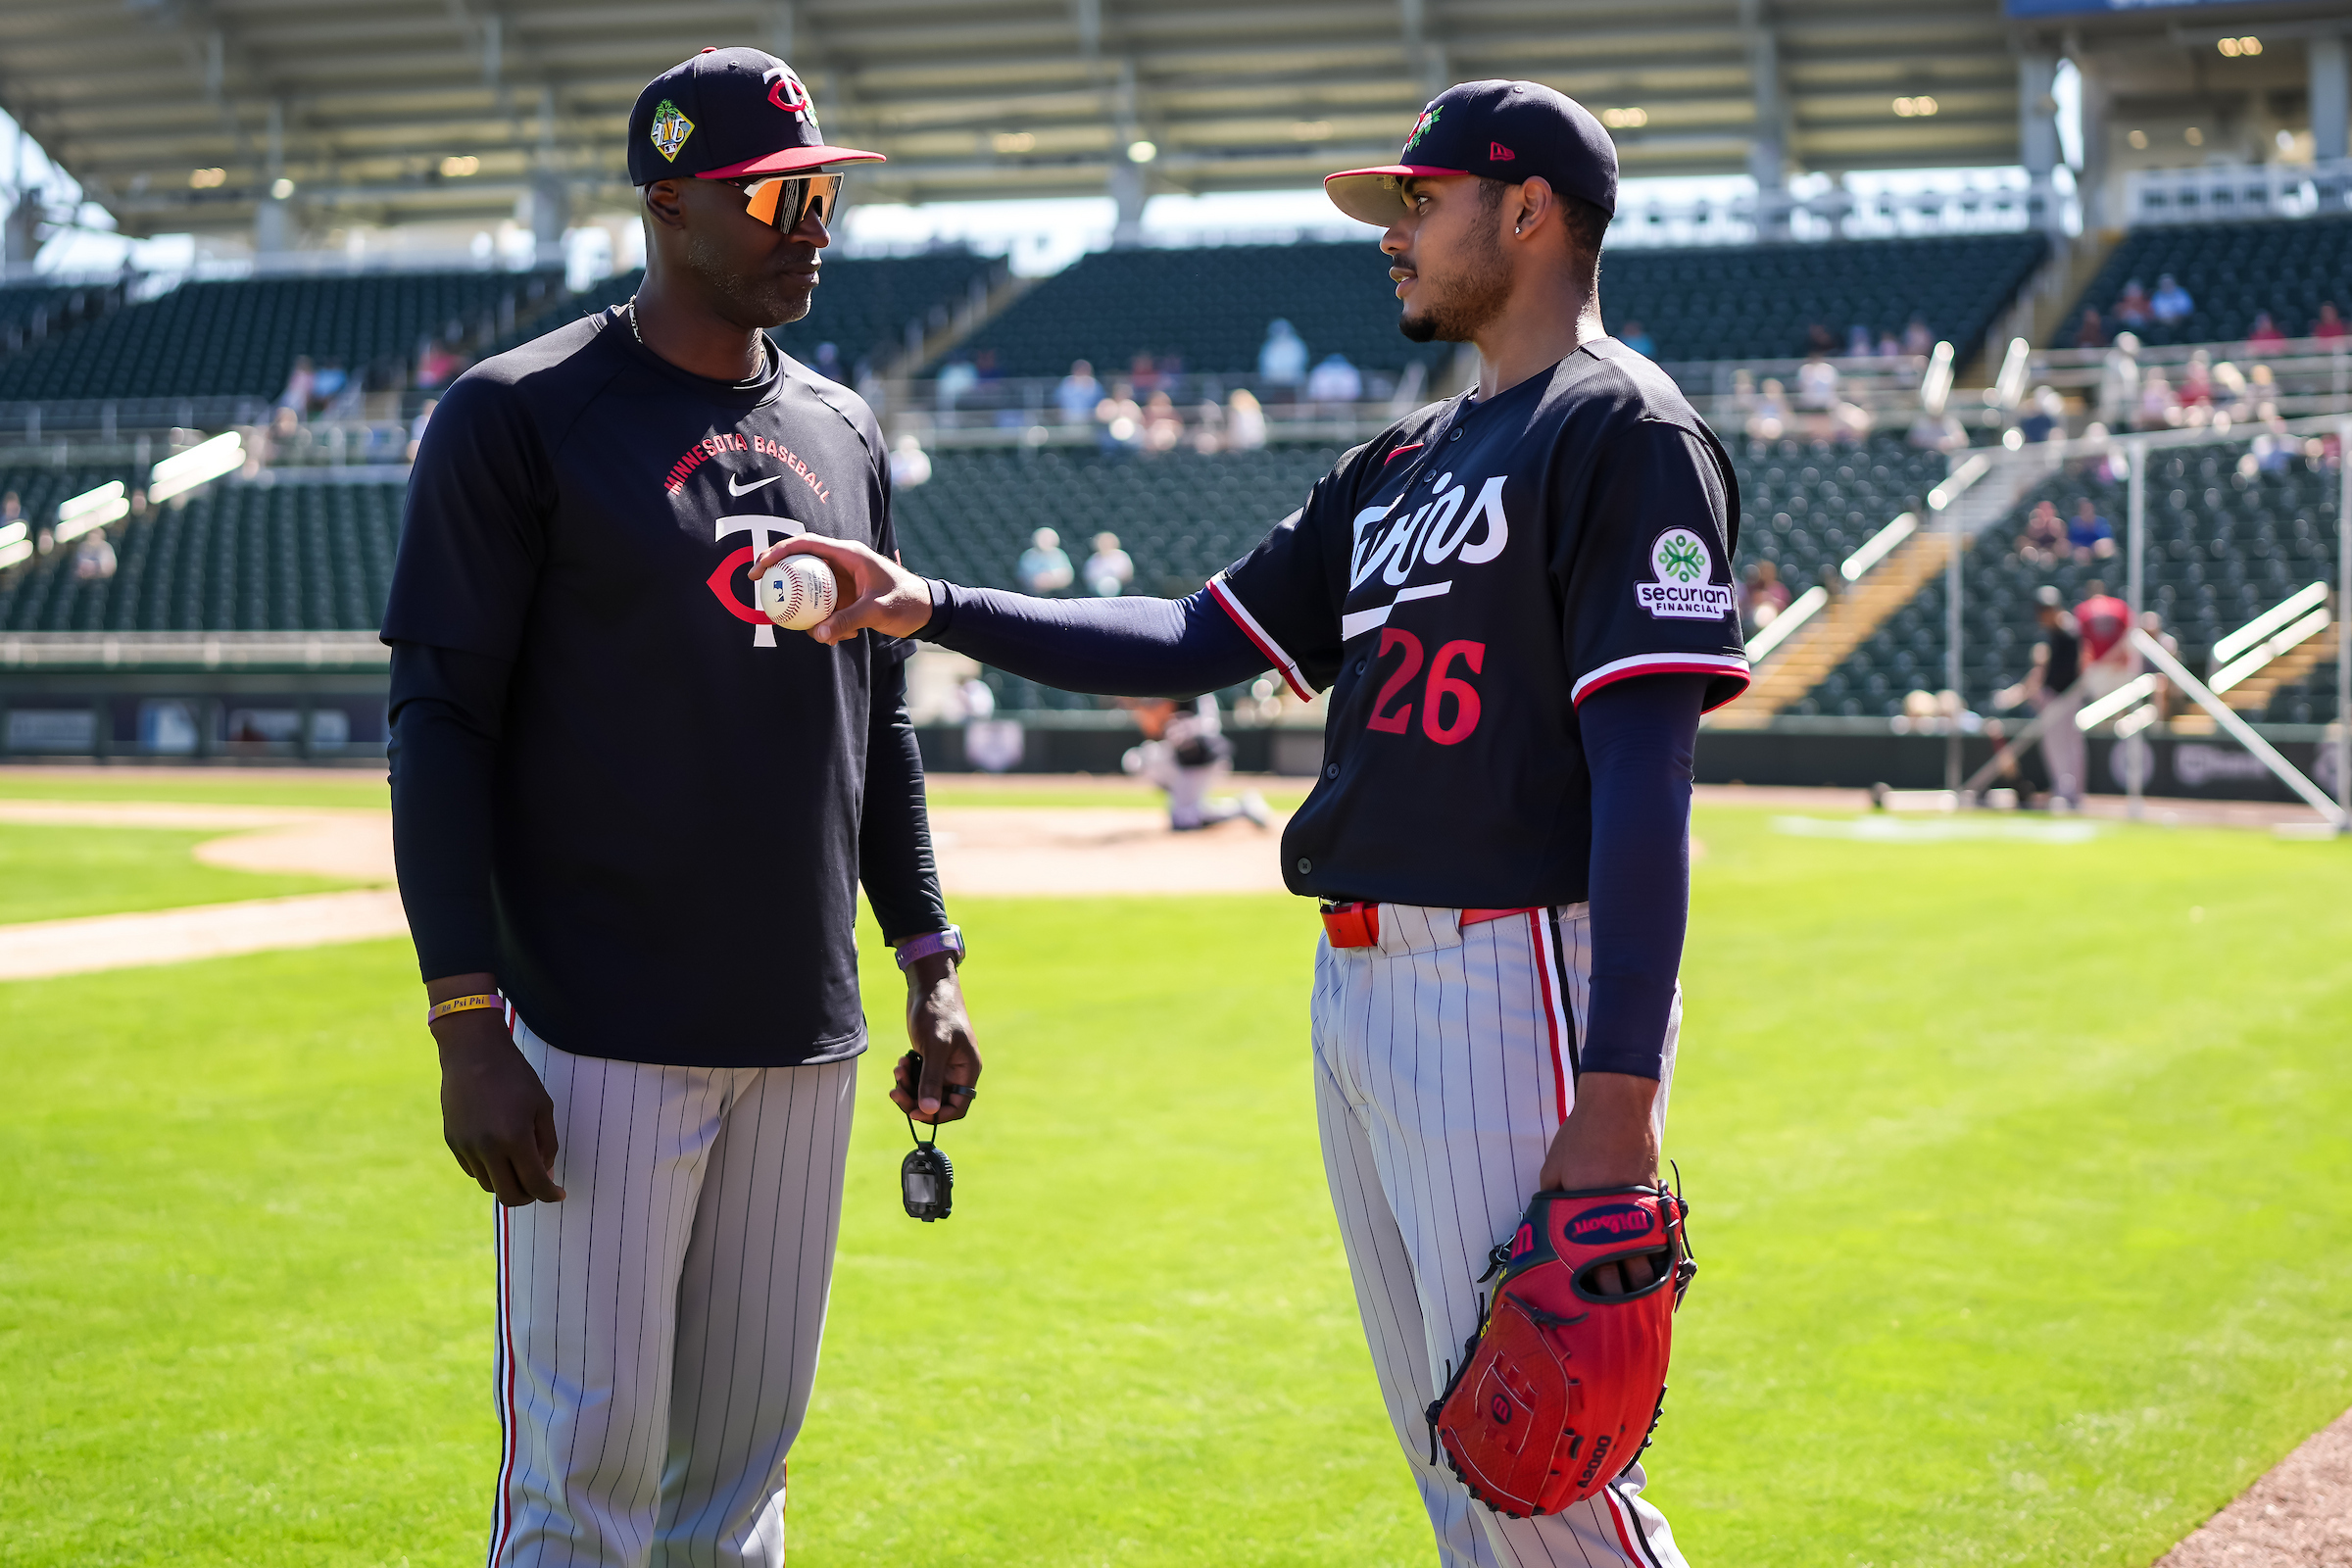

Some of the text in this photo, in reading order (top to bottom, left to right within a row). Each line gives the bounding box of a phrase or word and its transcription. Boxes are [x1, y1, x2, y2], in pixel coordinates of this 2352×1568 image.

[663, 433, 830, 504] MINNESOTA BASEBALL
[1642, 587, 1729, 605] securian
[1656, 603, 1720, 614] FINANCIAL
[1366, 627, 1487, 746] 26
[469, 996, 485, 1005] Phi
[1574, 1210, 1649, 1235] Wilson
[1577, 1435, 1612, 1488] A2000
